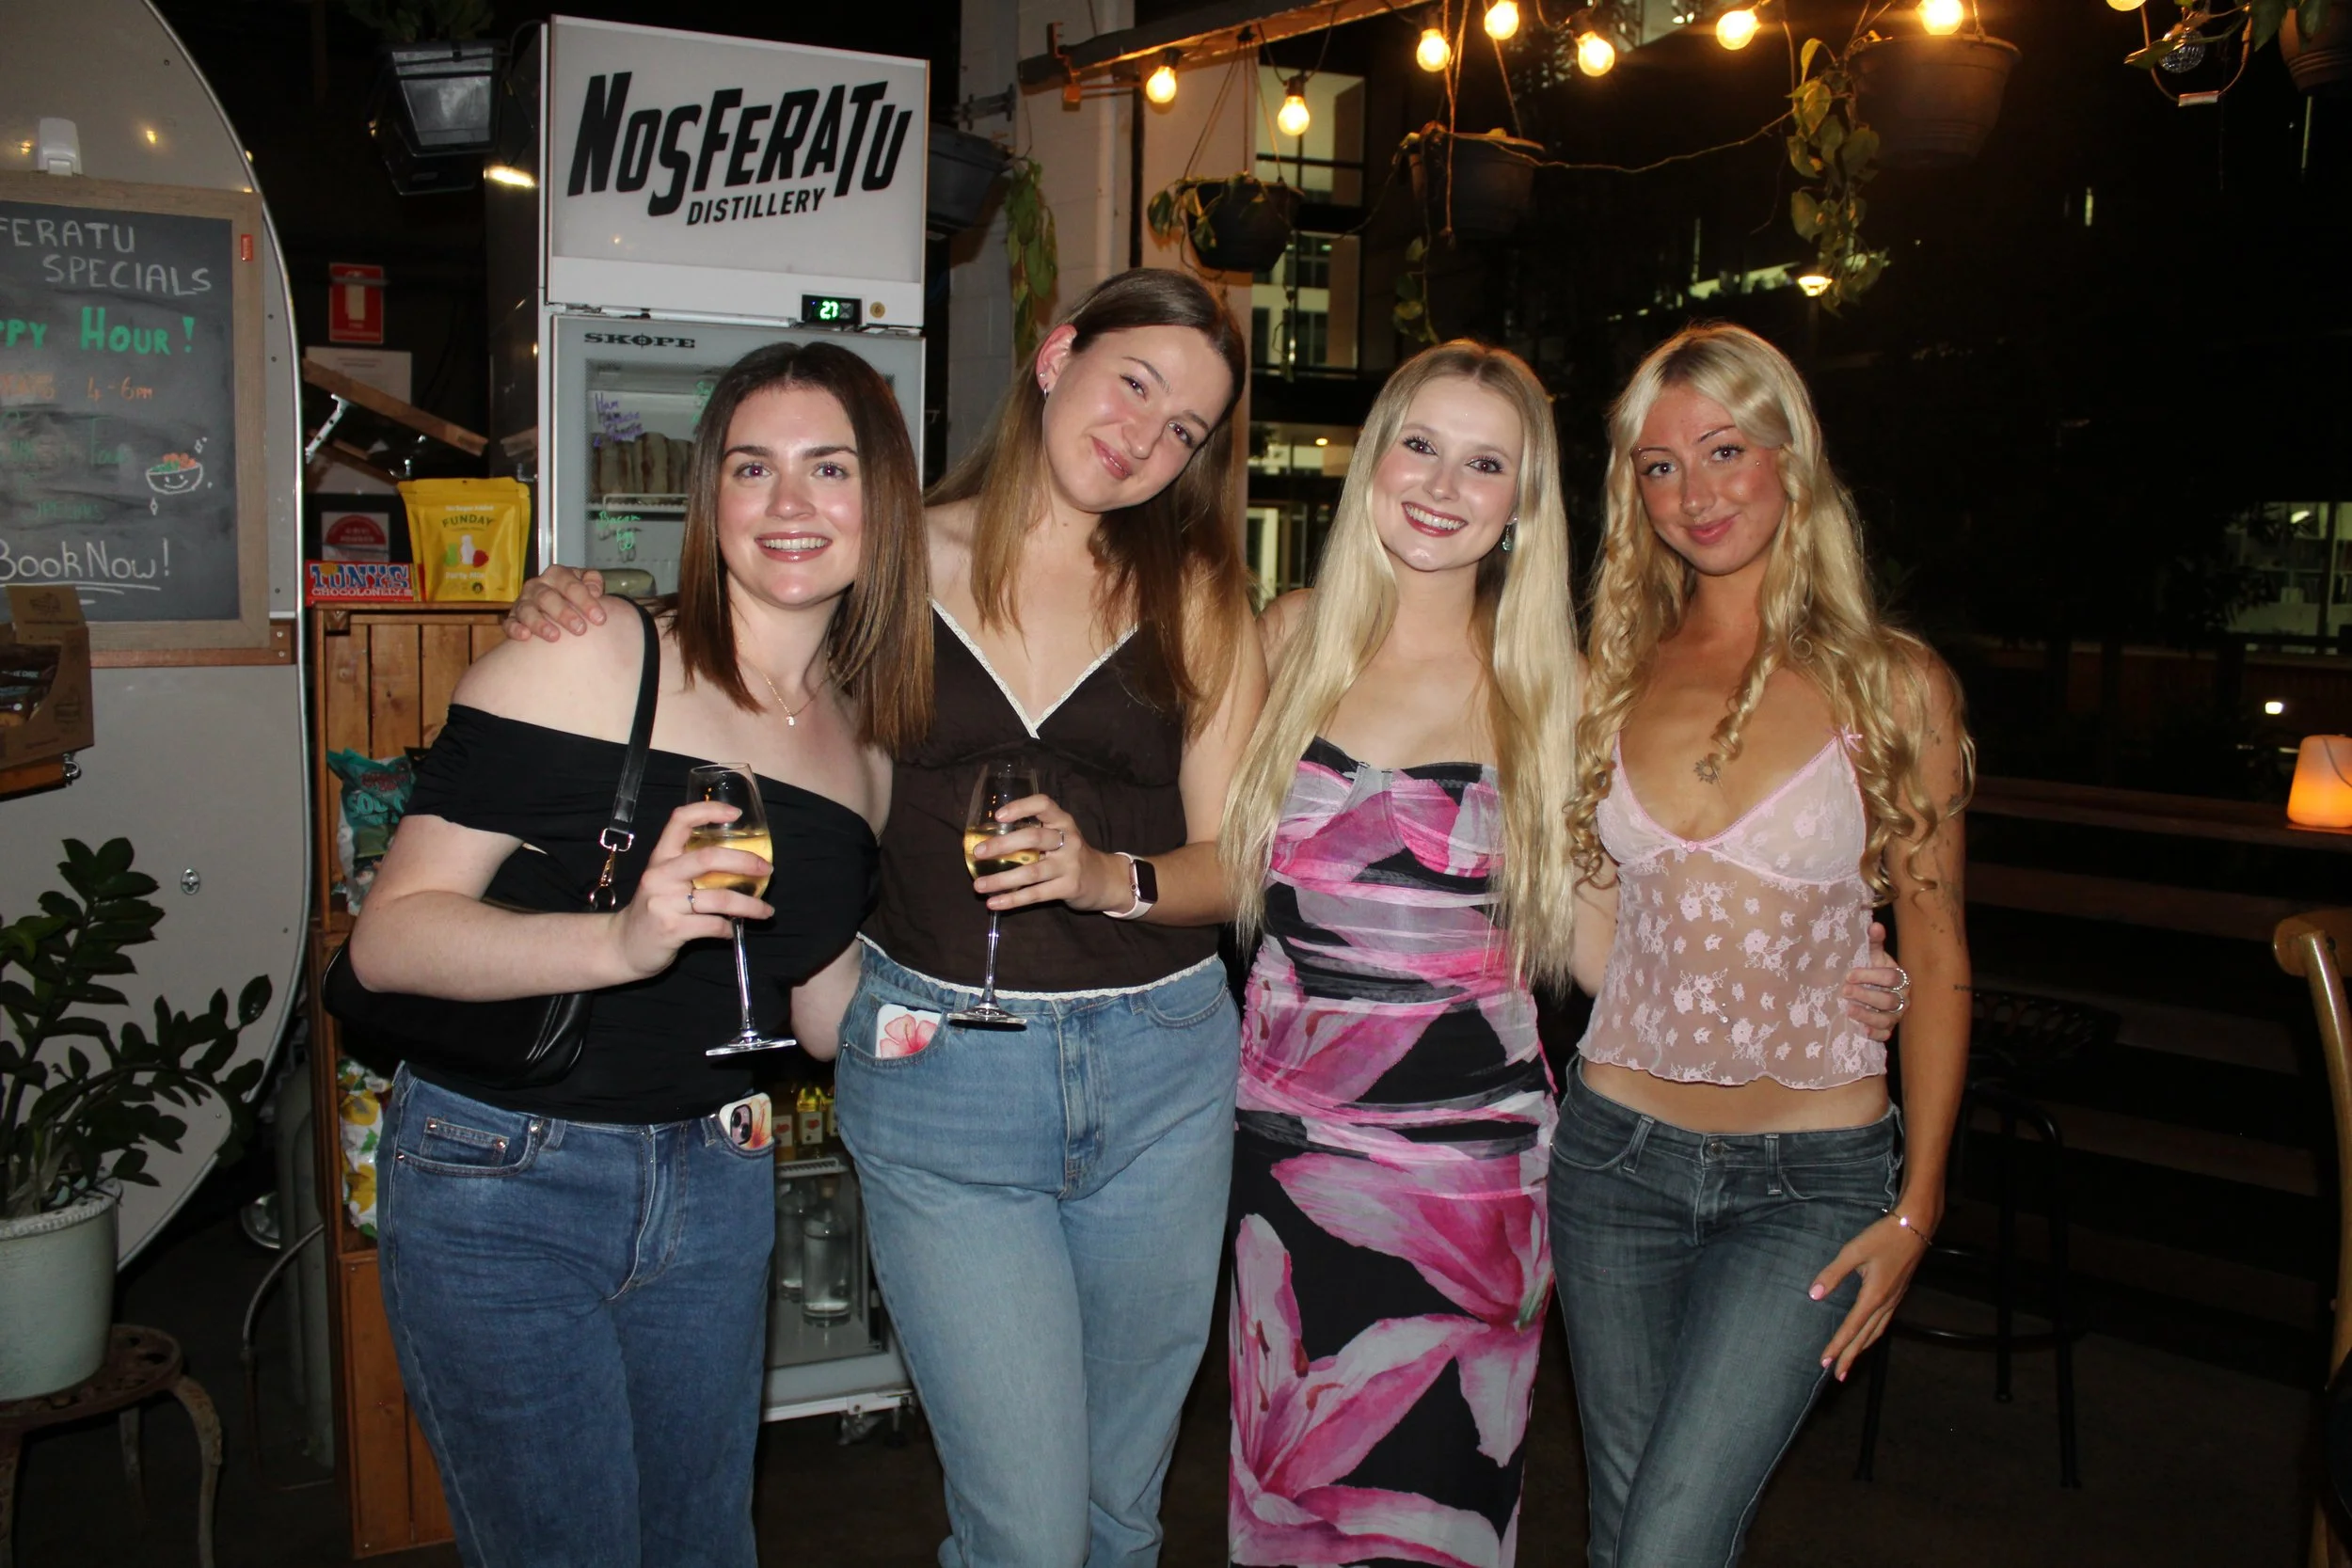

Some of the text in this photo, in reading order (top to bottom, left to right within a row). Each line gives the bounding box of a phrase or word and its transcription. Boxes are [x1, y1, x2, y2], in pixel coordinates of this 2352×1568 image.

[566, 71, 913, 216] NOSFERATU
[686, 187, 826, 226] DISTILLERY
[42, 254, 213, 296] SPECIALS
[819, 300, 839, 320] 27
[584, 332, 695, 349] SKOPE
[442, 514, 494, 528] FUNDAY
